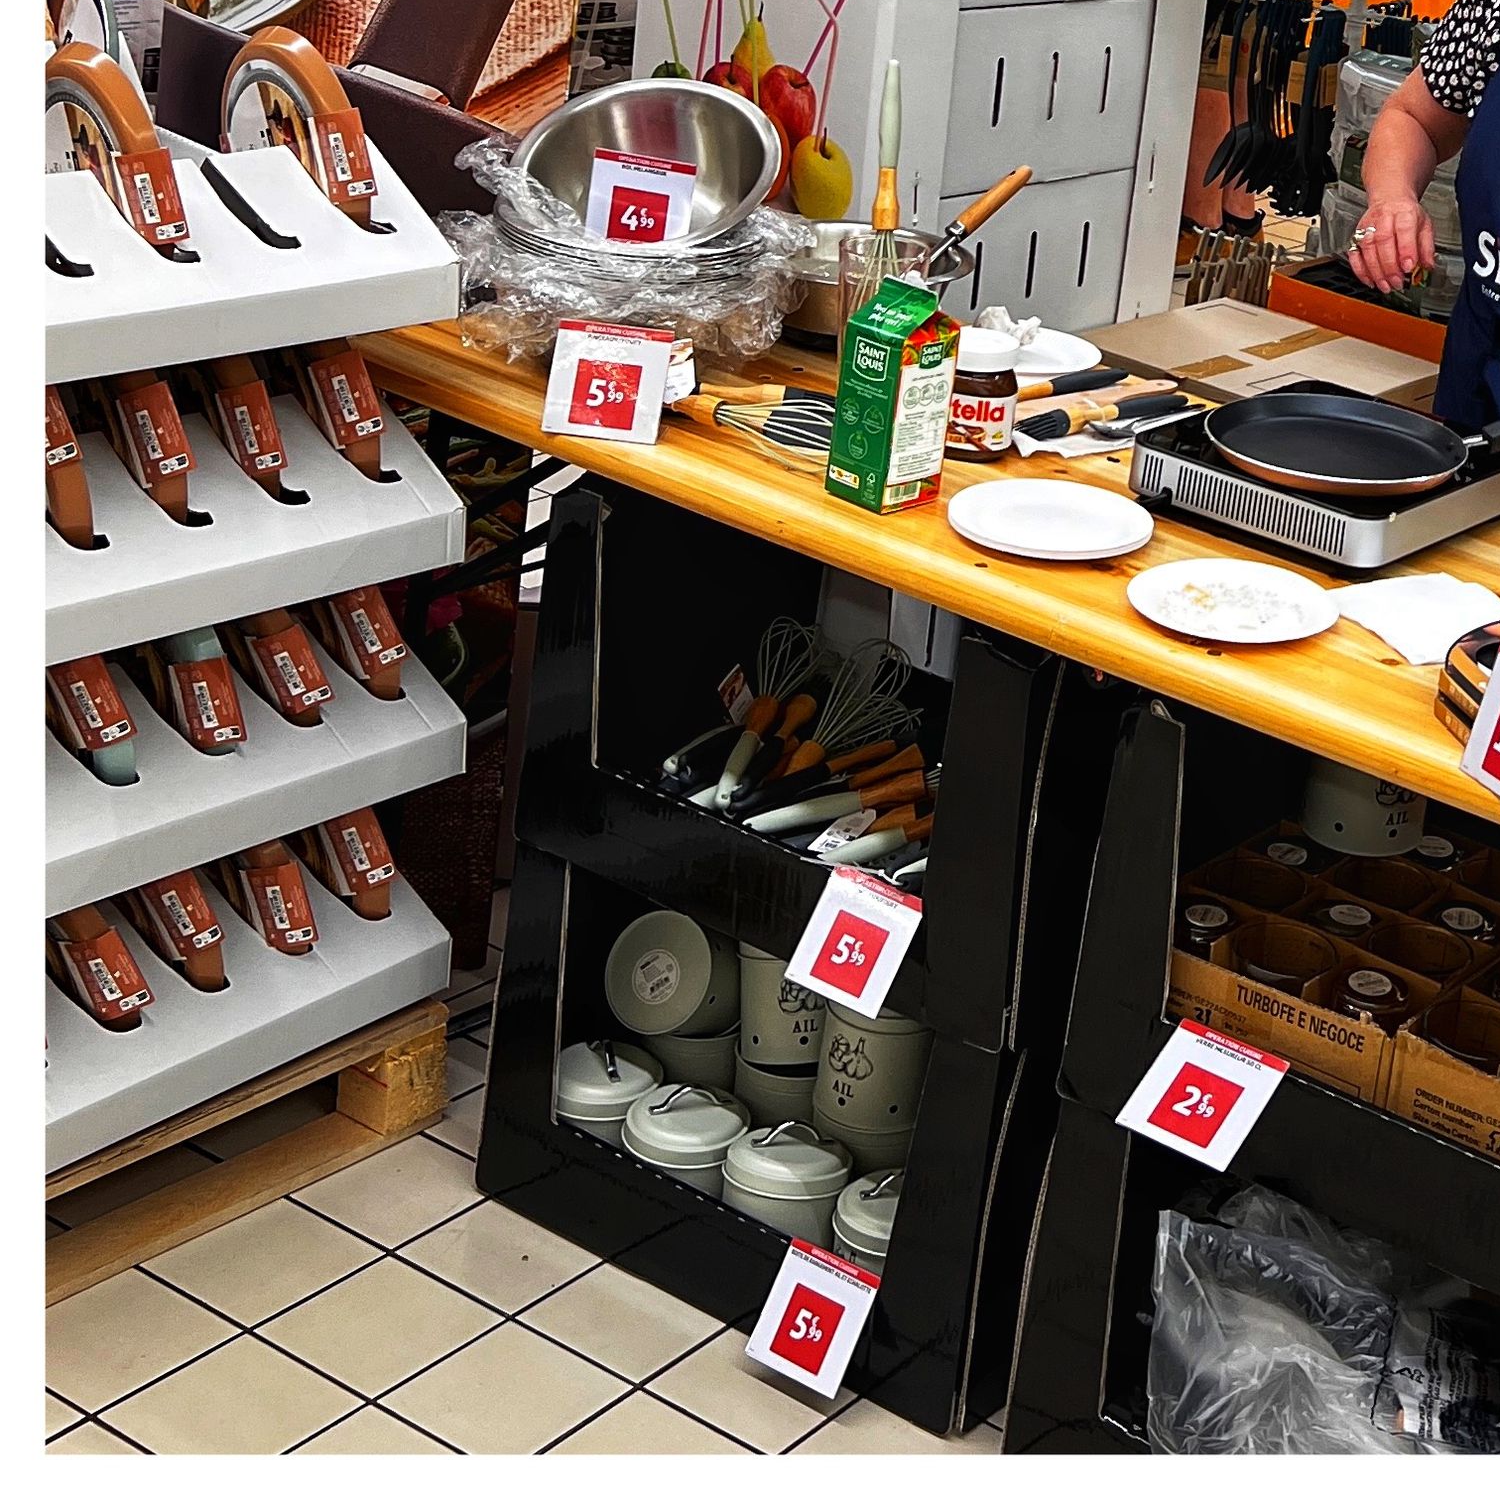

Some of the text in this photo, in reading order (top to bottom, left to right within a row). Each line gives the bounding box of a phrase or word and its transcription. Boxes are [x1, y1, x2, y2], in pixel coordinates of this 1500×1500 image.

[857, 341, 886, 360] SAINT
[922, 344, 943, 355] SAINT
[857, 354, 885, 372] LOUIS
[921, 352, 943, 366] LOUIS
[1386, 811, 1409, 827] AIL
[793, 1019, 818, 1034] AIL
[1237, 984, 1296, 1025] TURBOFE
[1297, 1010, 1306, 1028] E
[1309, 1017, 1366, 1053] NEGOCE
[832, 1079, 854, 1099] AIL
[1415, 1087, 1444, 1107] ORDER
[1413, 1099, 1441, 1117] Carton
